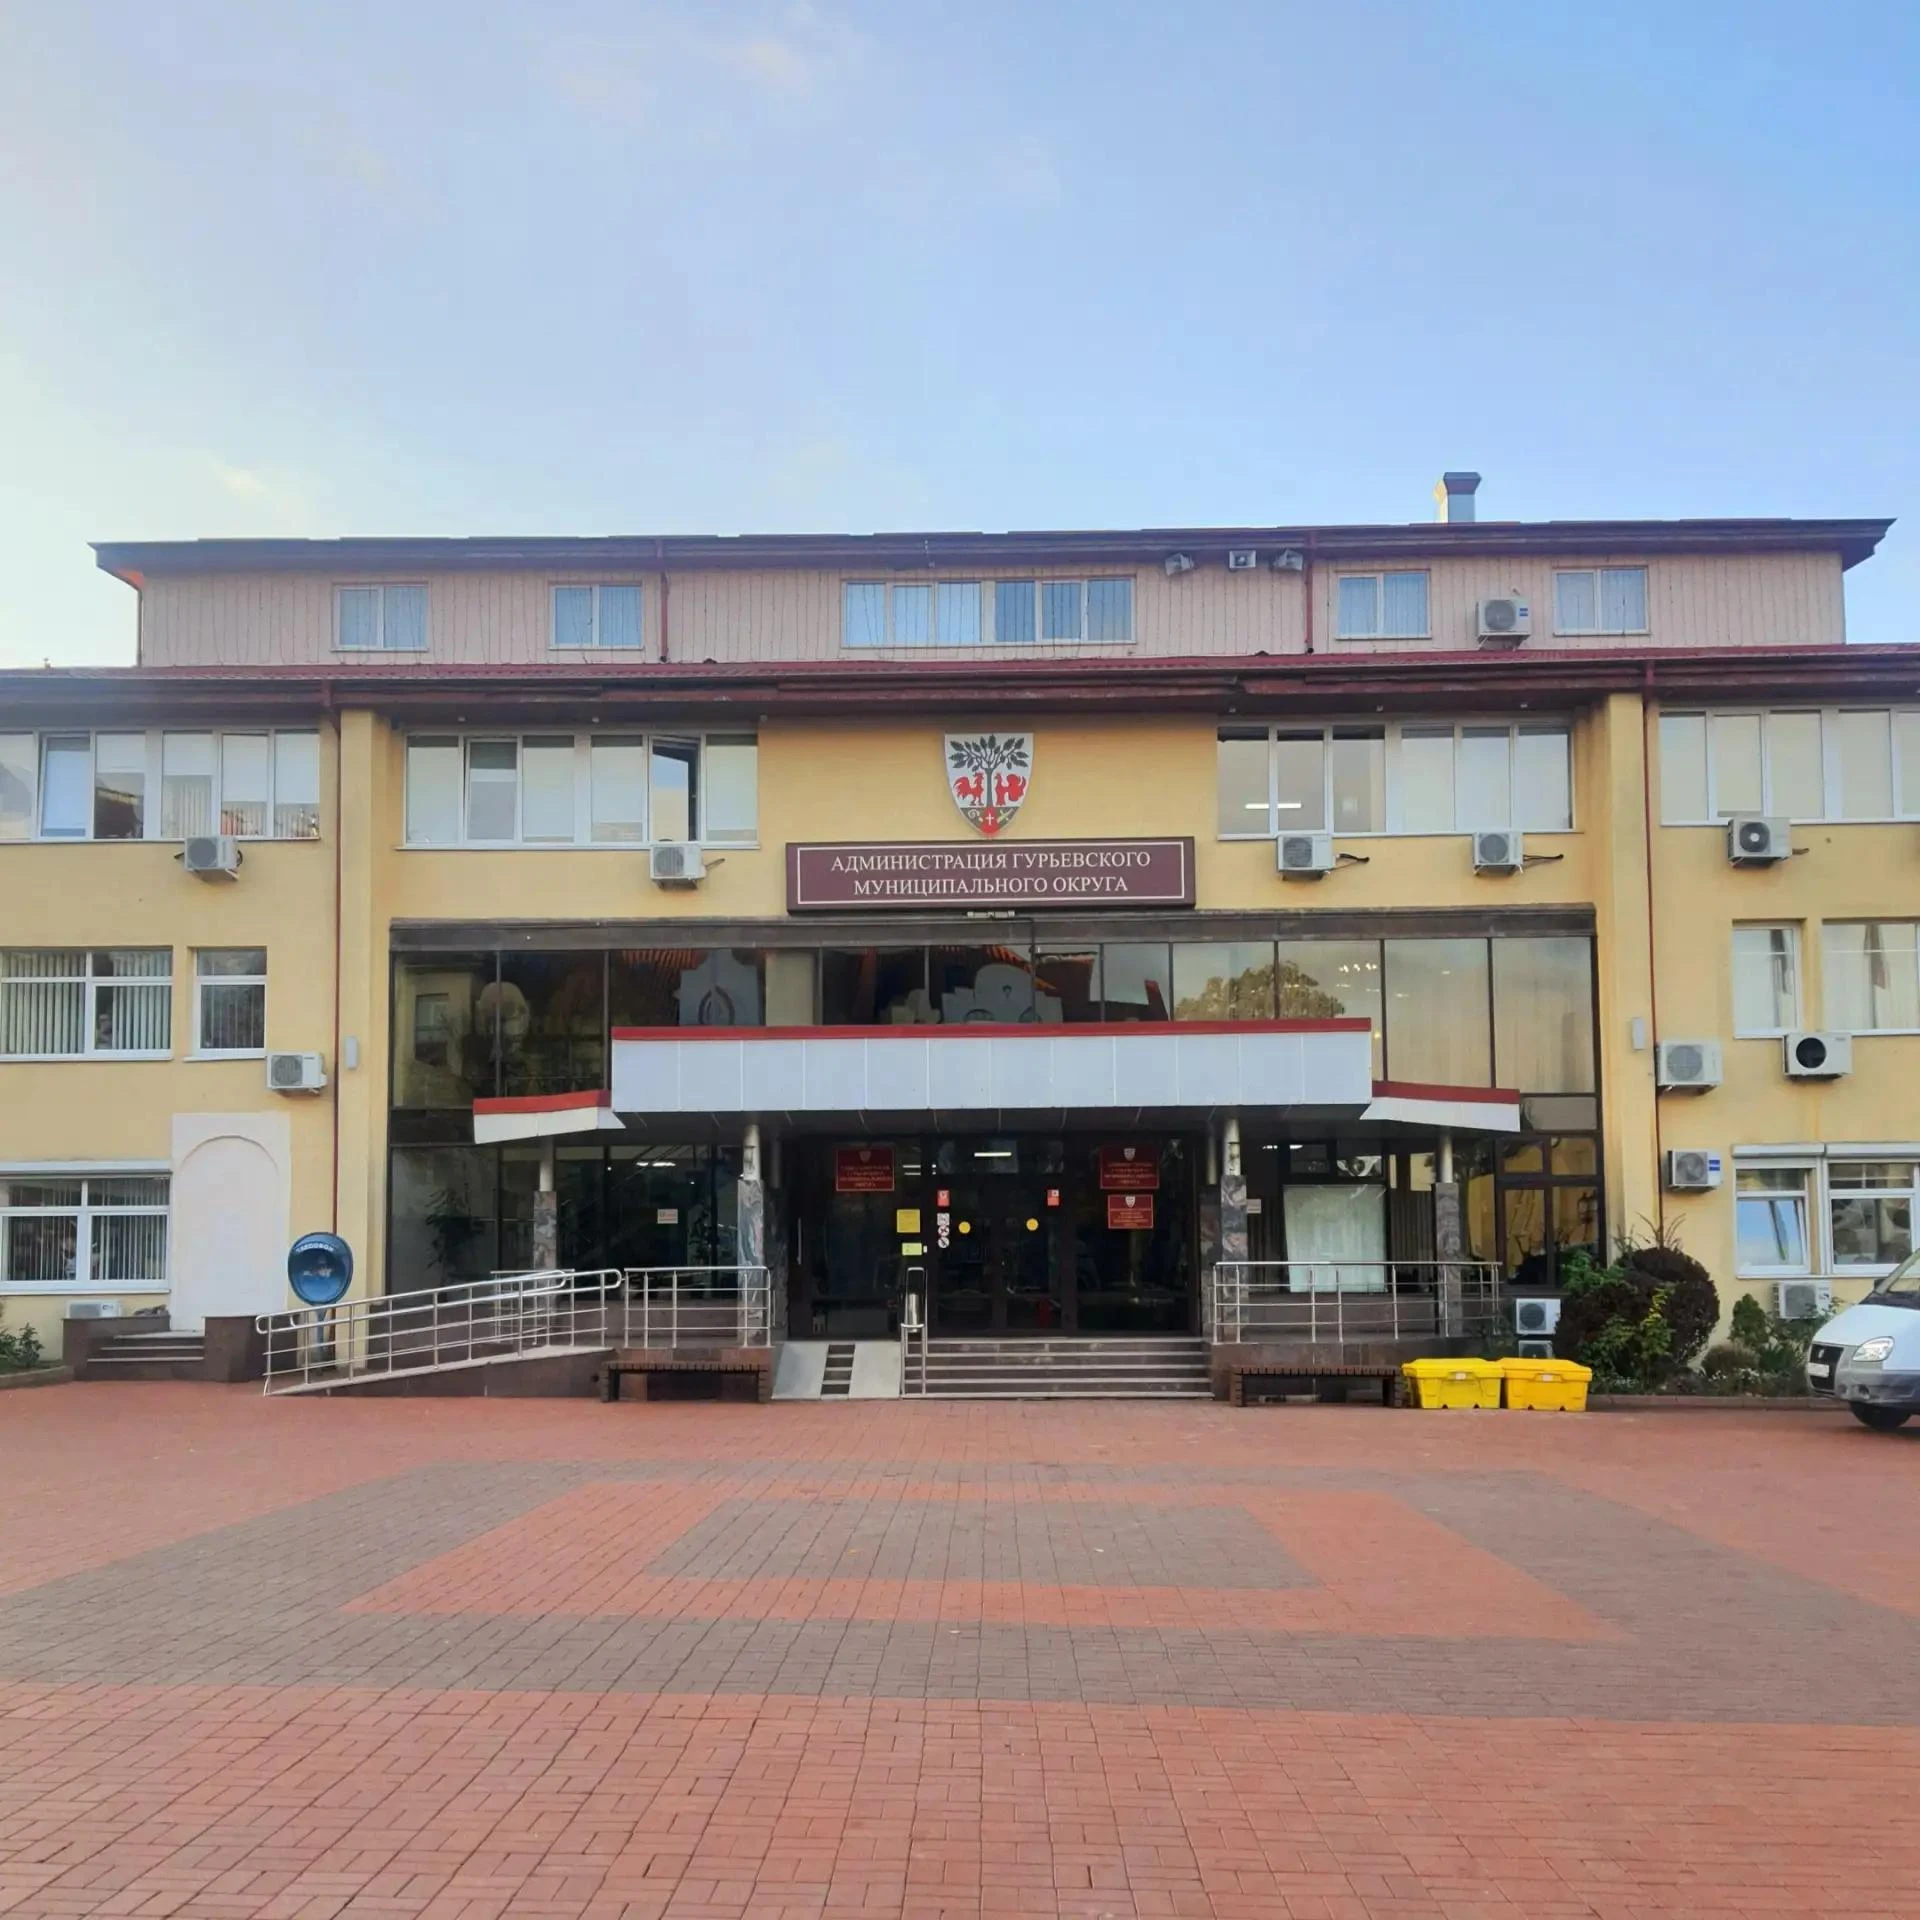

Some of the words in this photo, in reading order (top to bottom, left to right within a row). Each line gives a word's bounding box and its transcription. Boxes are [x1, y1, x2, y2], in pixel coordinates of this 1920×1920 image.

[832, 854, 1006, 873] АДМИНИСТРАЦИЯ
[1013, 852, 1151, 868] ГУРЬЕВСКОГО
[854, 877, 1048, 896] МУНИЦИПАЛЬНОГО
[1053, 877, 1128, 892] ОКРУГА
